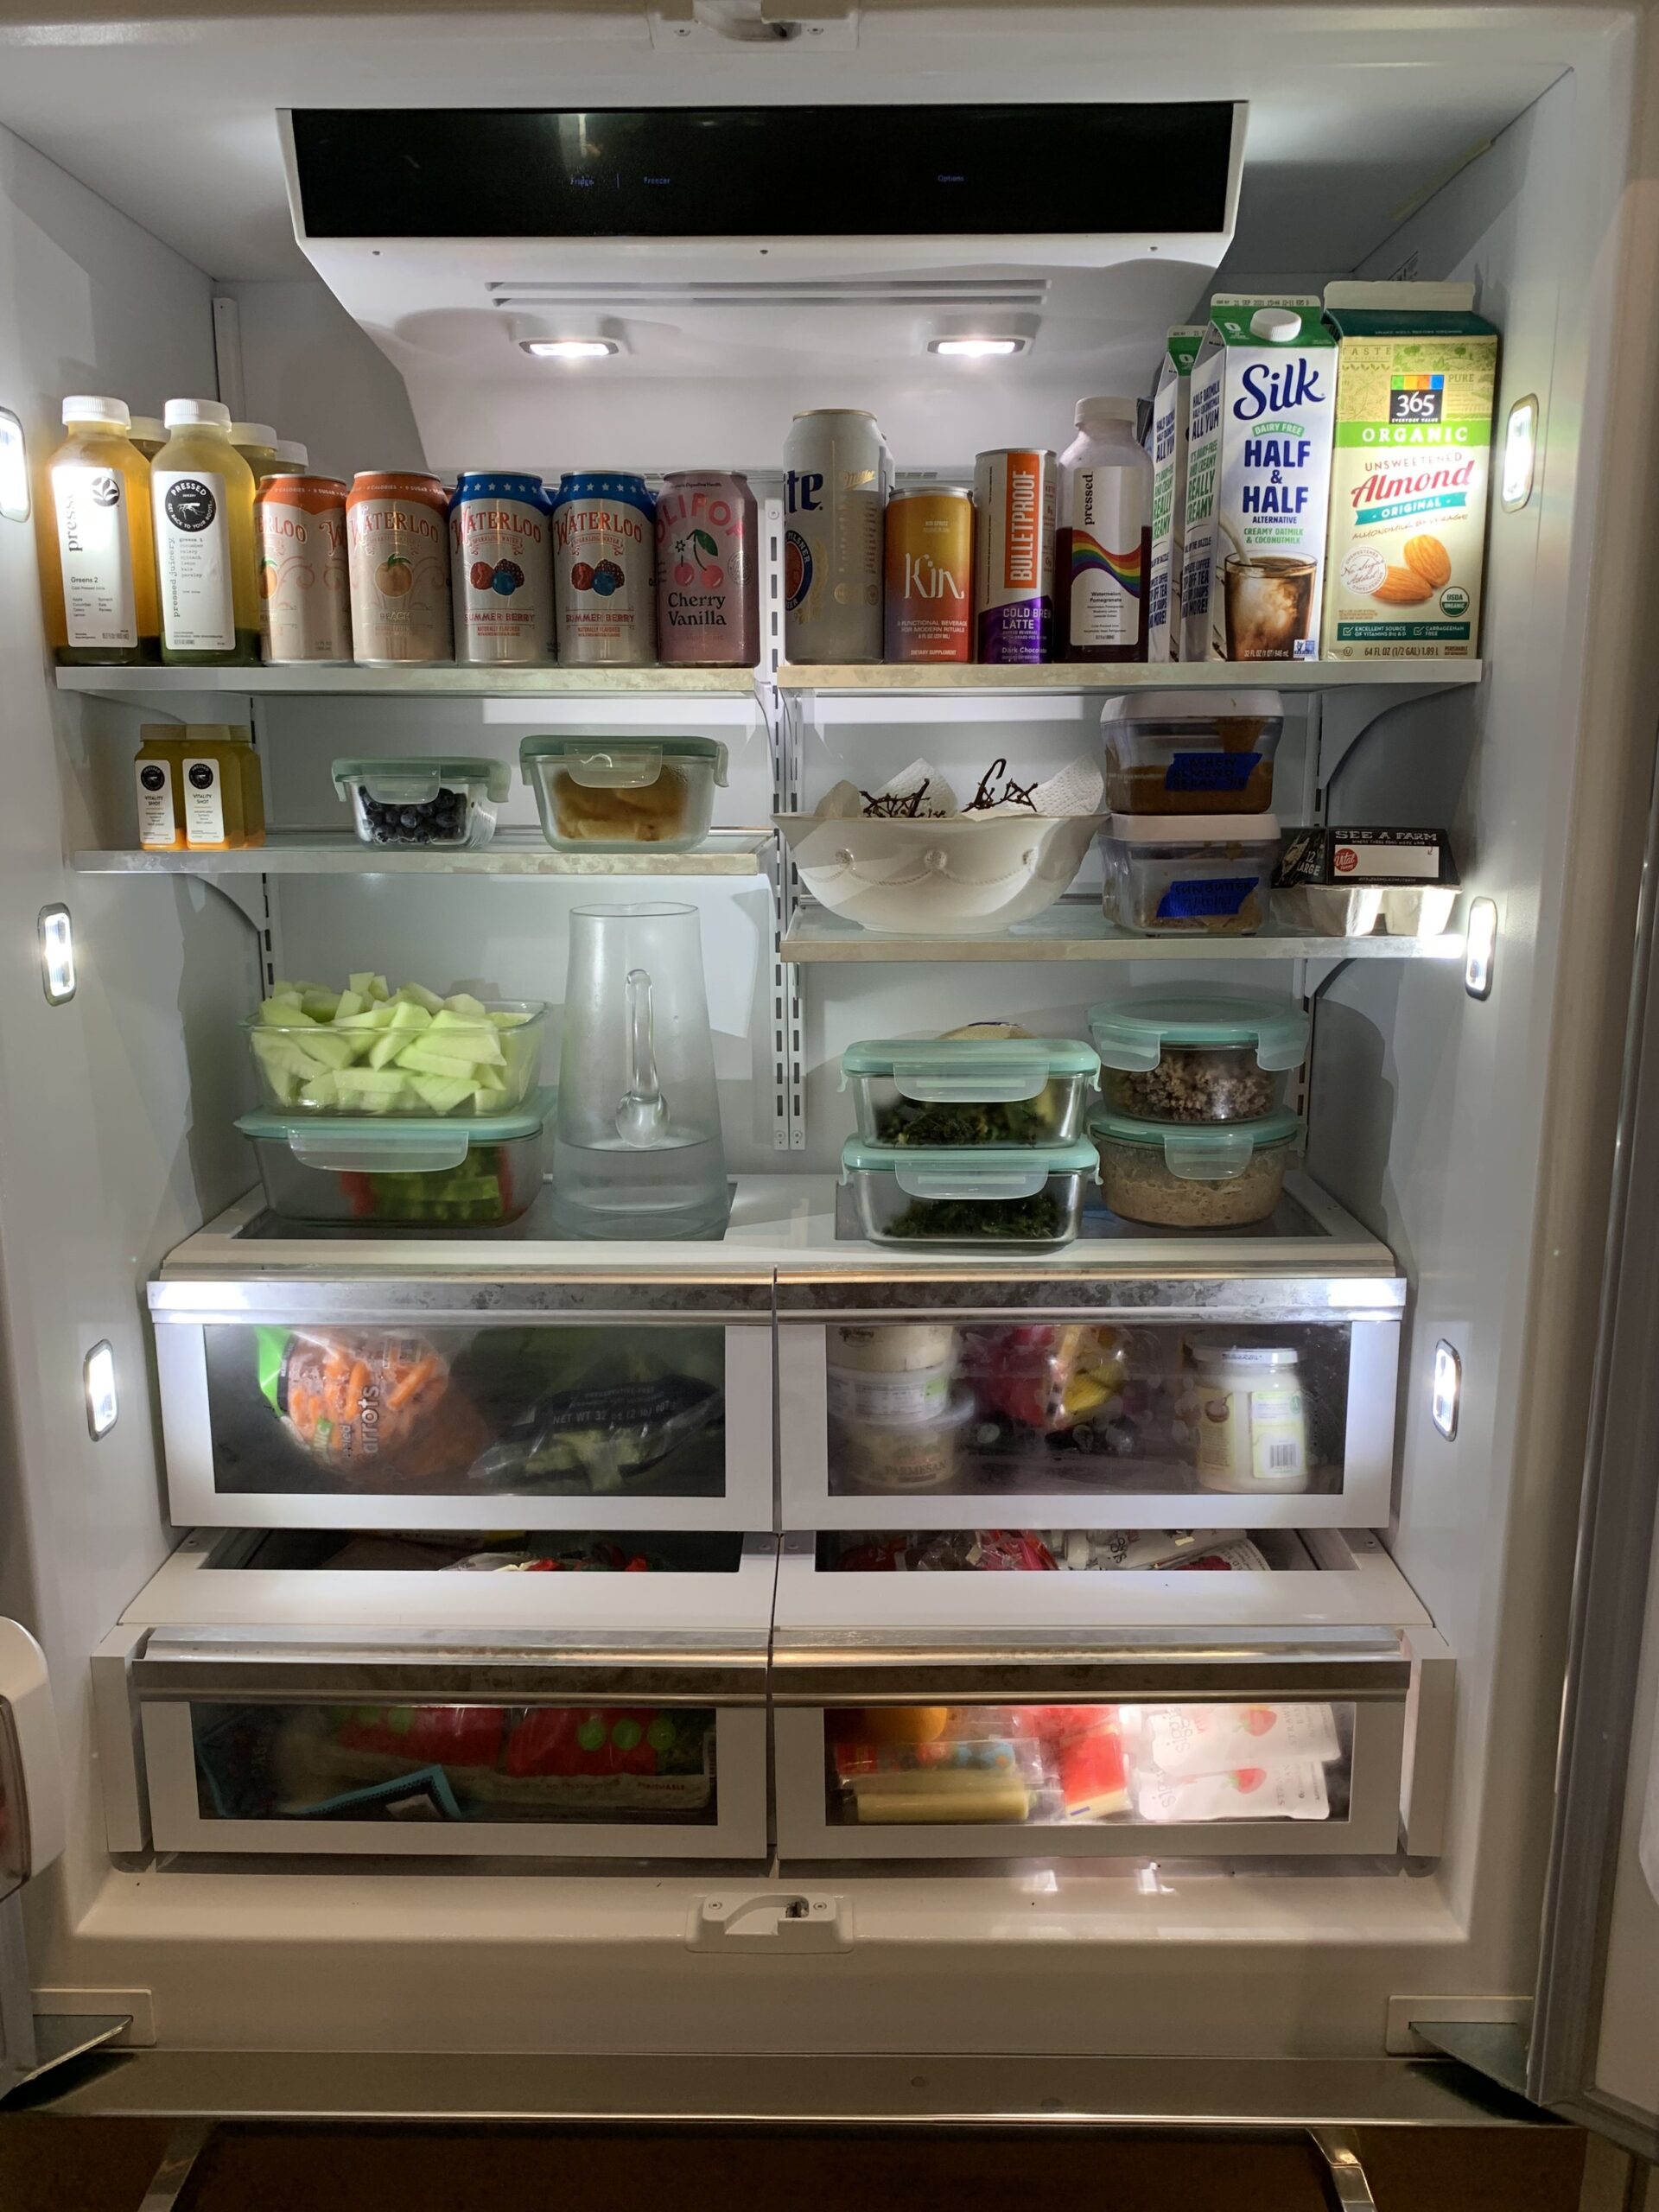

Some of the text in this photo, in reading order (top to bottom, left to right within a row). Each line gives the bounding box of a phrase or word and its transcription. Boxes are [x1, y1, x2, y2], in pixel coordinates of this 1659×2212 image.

[1233, 358, 1326, 421] Silk
[1395, 391, 1435, 416] 365
[1192, 418, 1203, 442] ALL
[1205, 407, 1219, 433] YUM
[1255, 423, 1302, 435] DAIRY FREE
[1362, 427, 1468, 442] ORGANIC
[1244, 440, 1311, 467] HALF
[1365, 453, 1462, 471] UNSWEETENED
[1188, 467, 1215, 502] REALLY
[1270, 469, 1283, 484] &
[1351, 460, 1475, 508] Almond
[171, 482, 207, 496] PRESSED
[1082, 473, 1095, 526] pressed
[1243, 486, 1309, 513] HALF
[1381, 497, 1442, 518] ORIGINAL
[171, 514, 183, 526] BACK
[193, 520, 206, 529] YOUR
[348, 505, 439, 550] WATERLOO
[450, 505, 542, 554] WATERLOO
[1010, 471, 1035, 581] BULLETPROOF
[554, 507, 642, 556] WATERLOO
[170, 579, 180, 619] pressed
[668, 593, 726, 609] Cherry
[464, 613, 535, 621] SUMMER BERRY
[668, 611, 727, 626] Vanilla
[1003, 608, 1030, 617] COLD
[1002, 620, 1034, 629] LATTE
[1364, 646, 1373, 656] 64
[1374, 646, 1381, 656] FL
[1382, 646, 1390, 656] OZ
[1392, 646, 1404, 657] (1/2
[1406, 646, 1421, 657] GAL)
[1422, 646, 1434, 656] 1.89
[1335, 830, 1373, 839] SEE
[1396, 831, 1437, 841] FARM
[1306, 850, 1316, 863] 12
[1296, 861, 1321, 876] LARGE
[576, 1411, 590, 1422] WT
